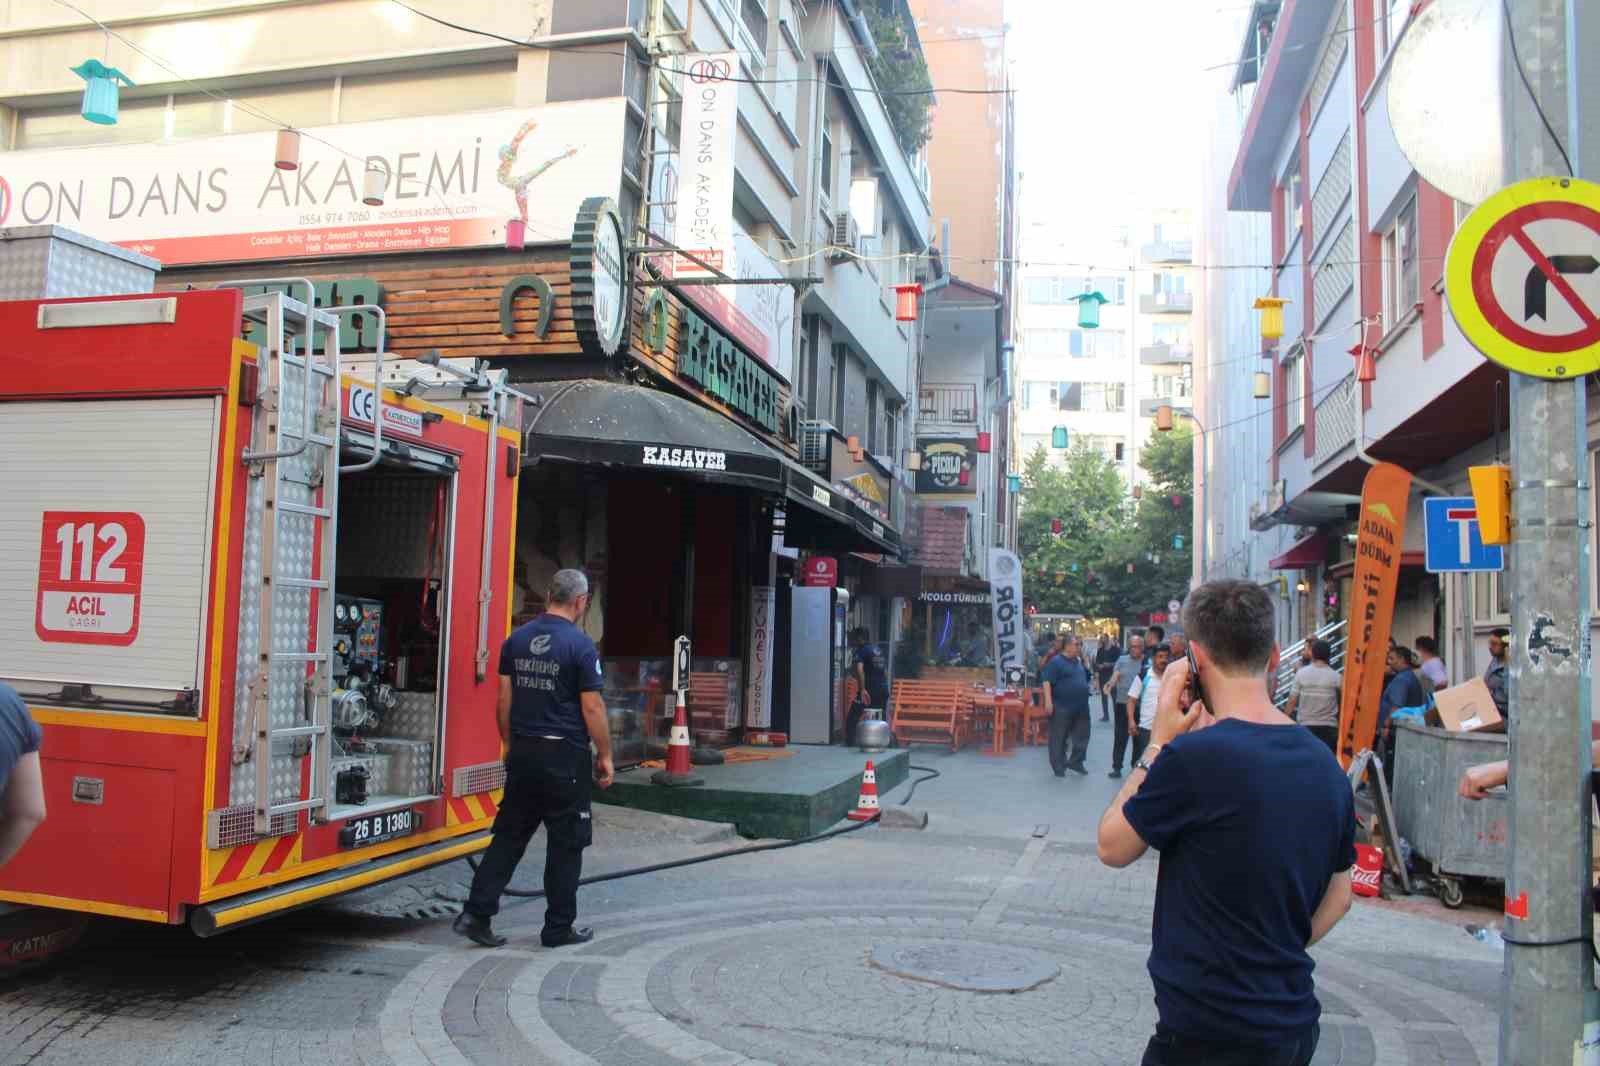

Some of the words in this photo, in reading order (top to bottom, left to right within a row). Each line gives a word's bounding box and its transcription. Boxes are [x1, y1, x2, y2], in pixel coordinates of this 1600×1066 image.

[702, 88, 716, 112] ON
[697, 120, 715, 164] DANS
[21, 180, 83, 225] ON
[108, 167, 229, 220] DANS
[256, 137, 481, 208] AKADEMİ
[642, 446, 727, 470] KASAVER
[56, 522, 128, 582] 112
[353, 819, 369, 841] 26
[373, 816, 383, 837] B
[386, 811, 411, 833] 1380
